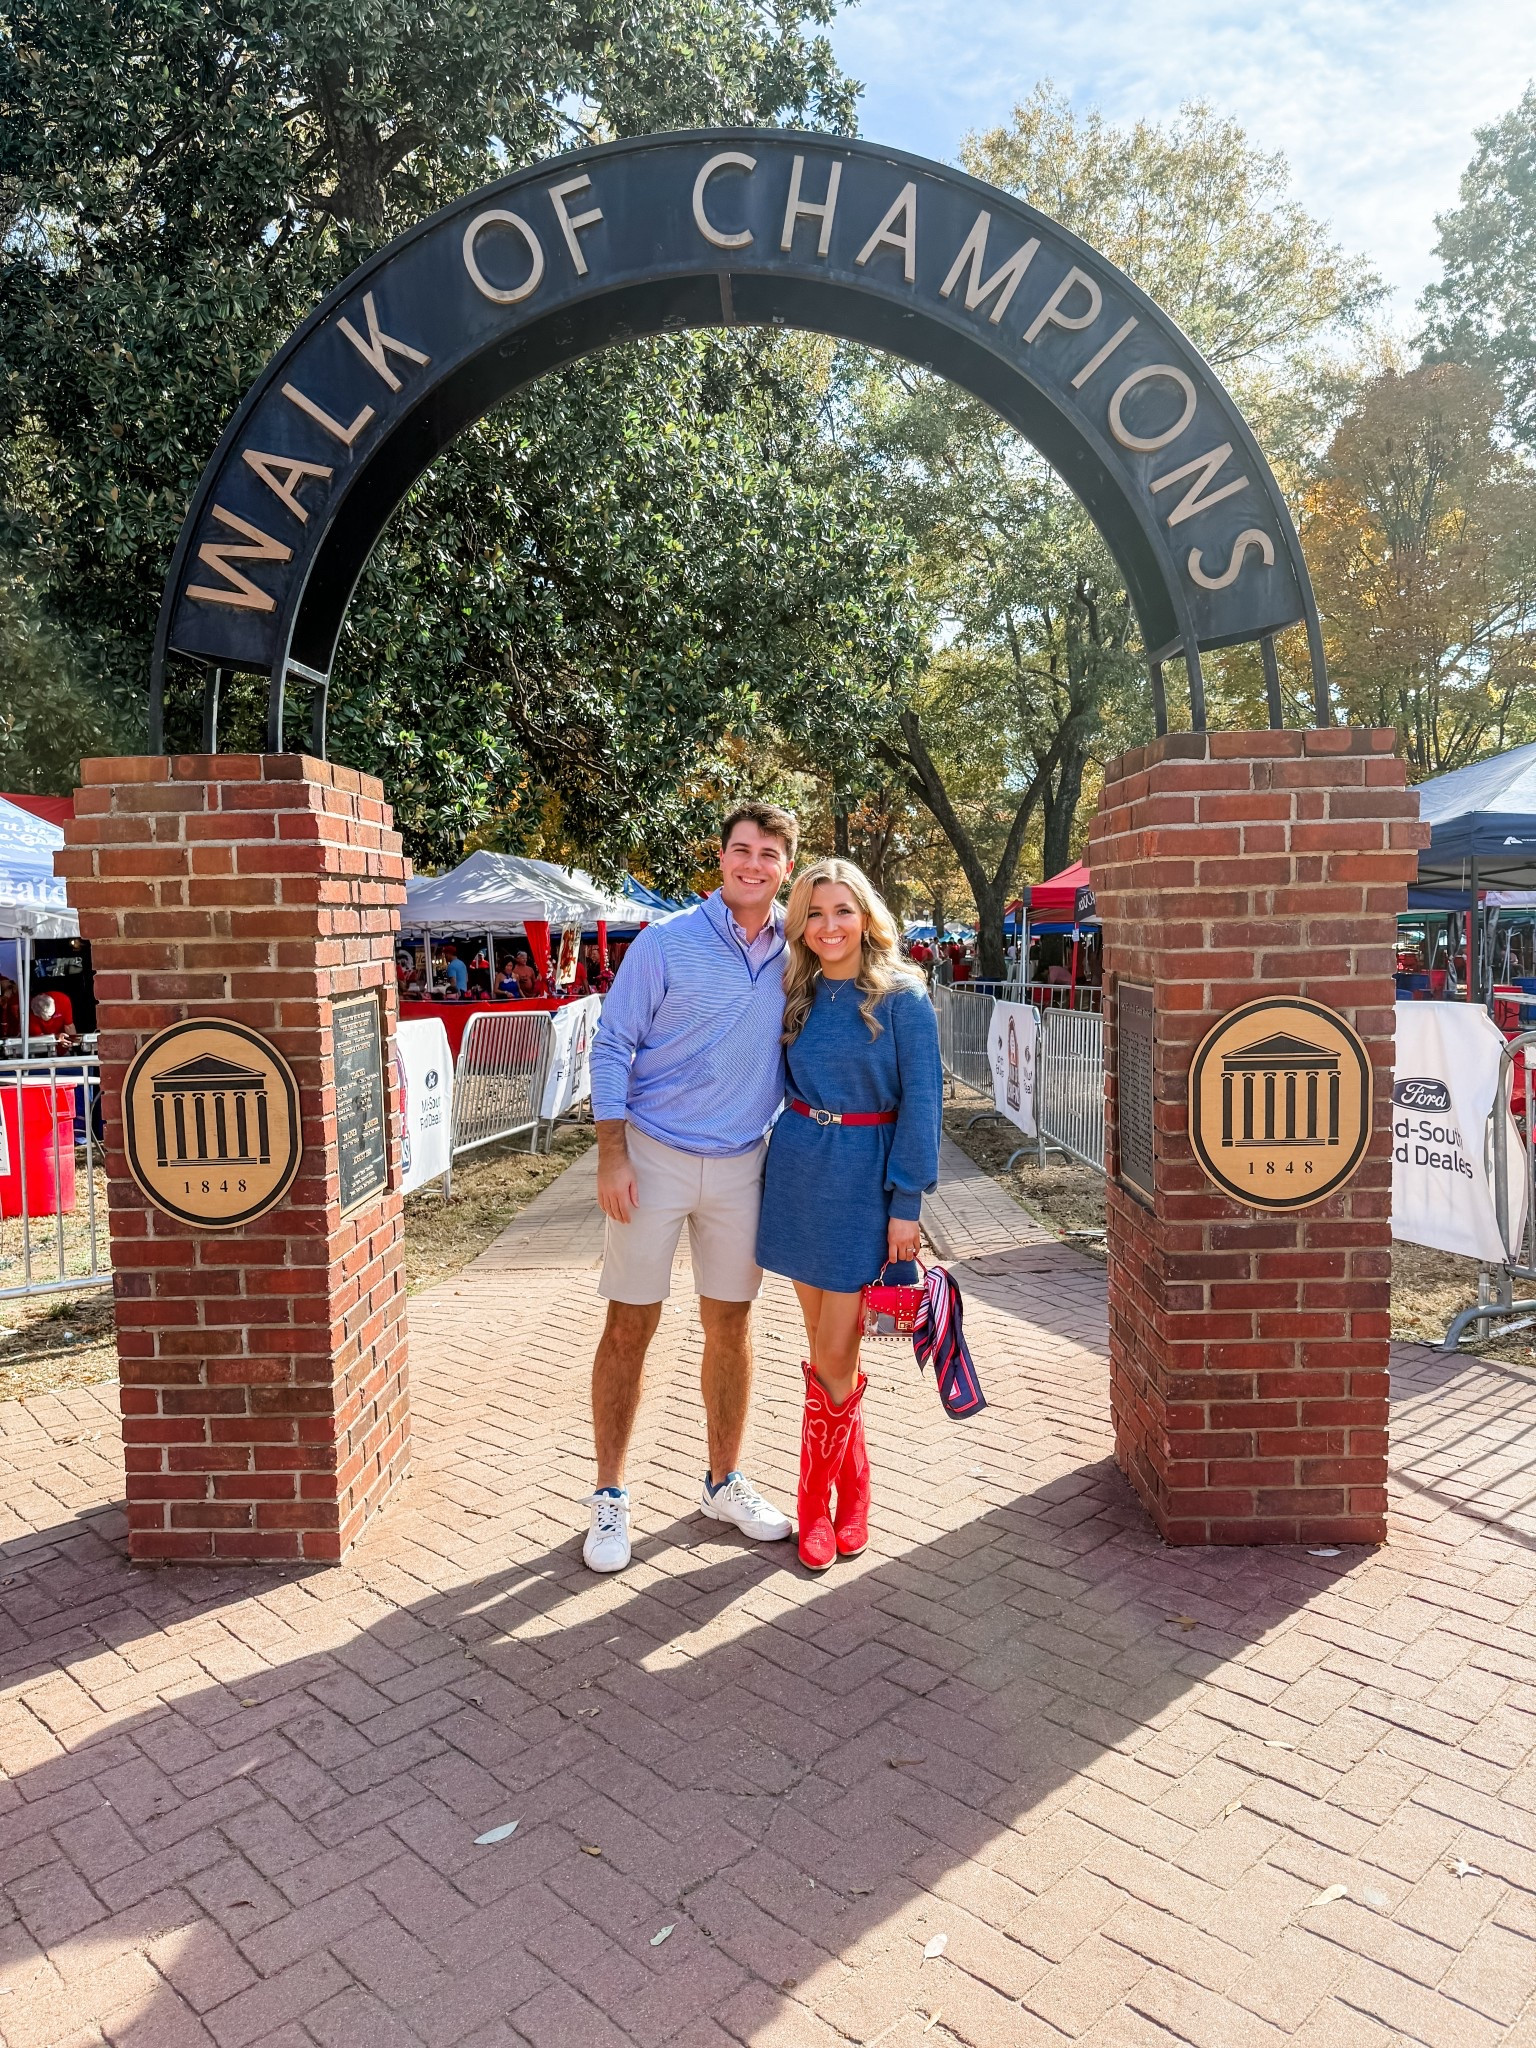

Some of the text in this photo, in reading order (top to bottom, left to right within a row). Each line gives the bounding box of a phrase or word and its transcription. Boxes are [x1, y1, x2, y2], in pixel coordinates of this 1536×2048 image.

[185, 151, 1276, 613] WALK OF CHAMPIONS
[1400, 1082, 1447, 1108] Ford
[1248, 1160, 1313, 1175] 1848
[1415, 1145, 1473, 1179] Deales
[184, 1179, 247, 1194] 1848
